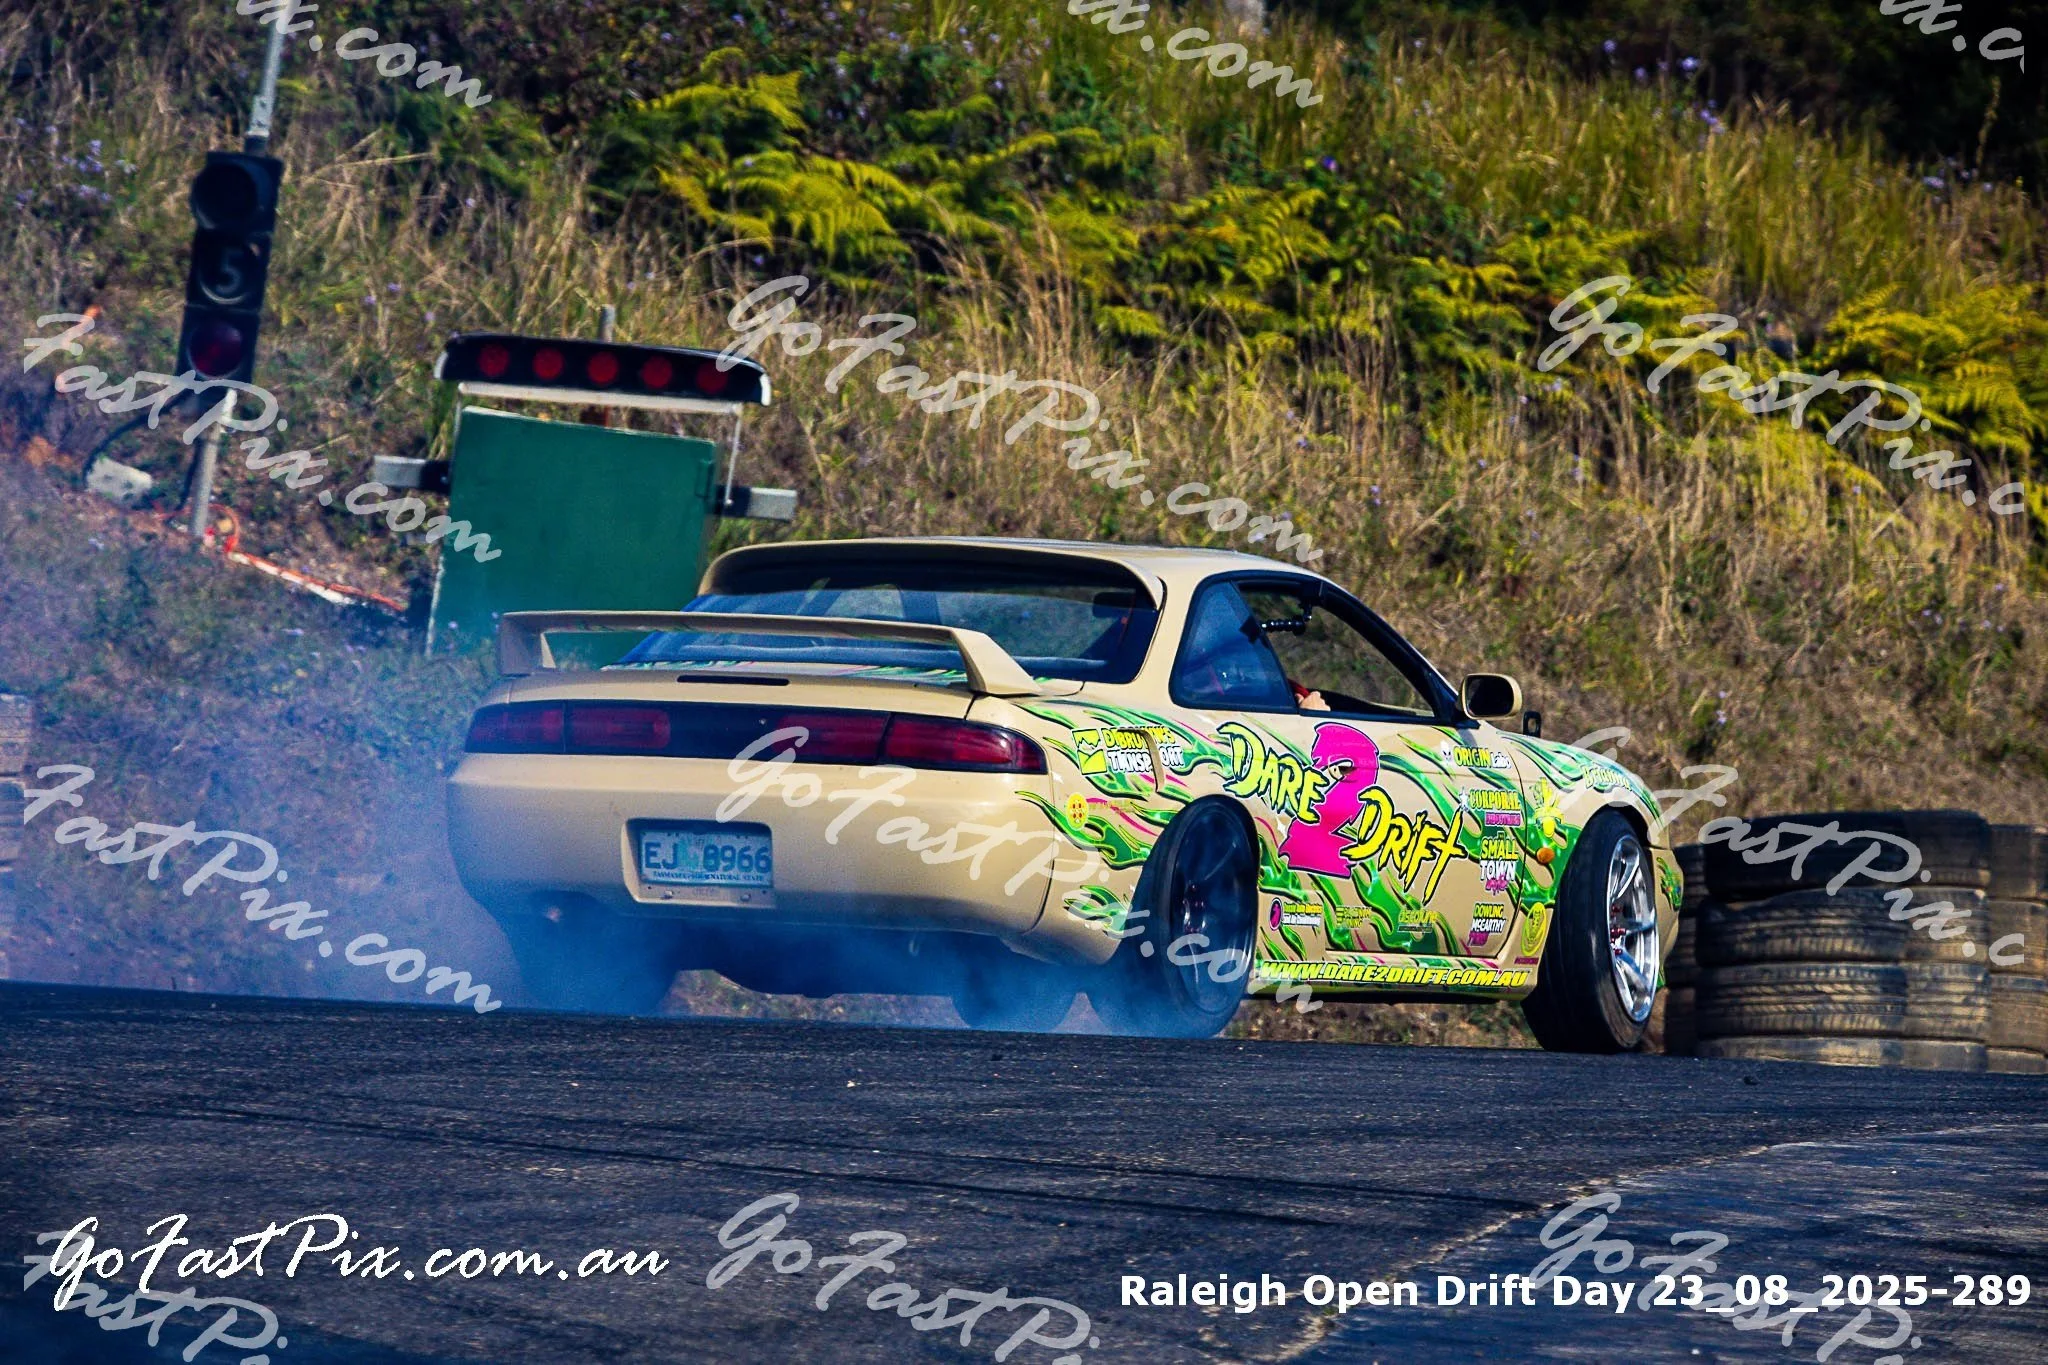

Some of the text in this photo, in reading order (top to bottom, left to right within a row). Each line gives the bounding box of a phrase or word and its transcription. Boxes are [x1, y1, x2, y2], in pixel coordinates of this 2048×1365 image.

[216, 248, 243, 293] 5
[1453, 746, 1491, 768] ORIGIN
[1216, 722, 1330, 824] DARE
[1279, 722, 1379, 879] 2
[1469, 789, 1521, 811] CORPORAL
[645, 842, 772, 874] EJ 8966
[1480, 837, 1519, 861] SMALL
[1479, 859, 1517, 881] TOWN
[1473, 902, 1505, 919] DOWLING
[1261, 961, 1530, 987] WWW.DARE2DRIFT.COM.AU
